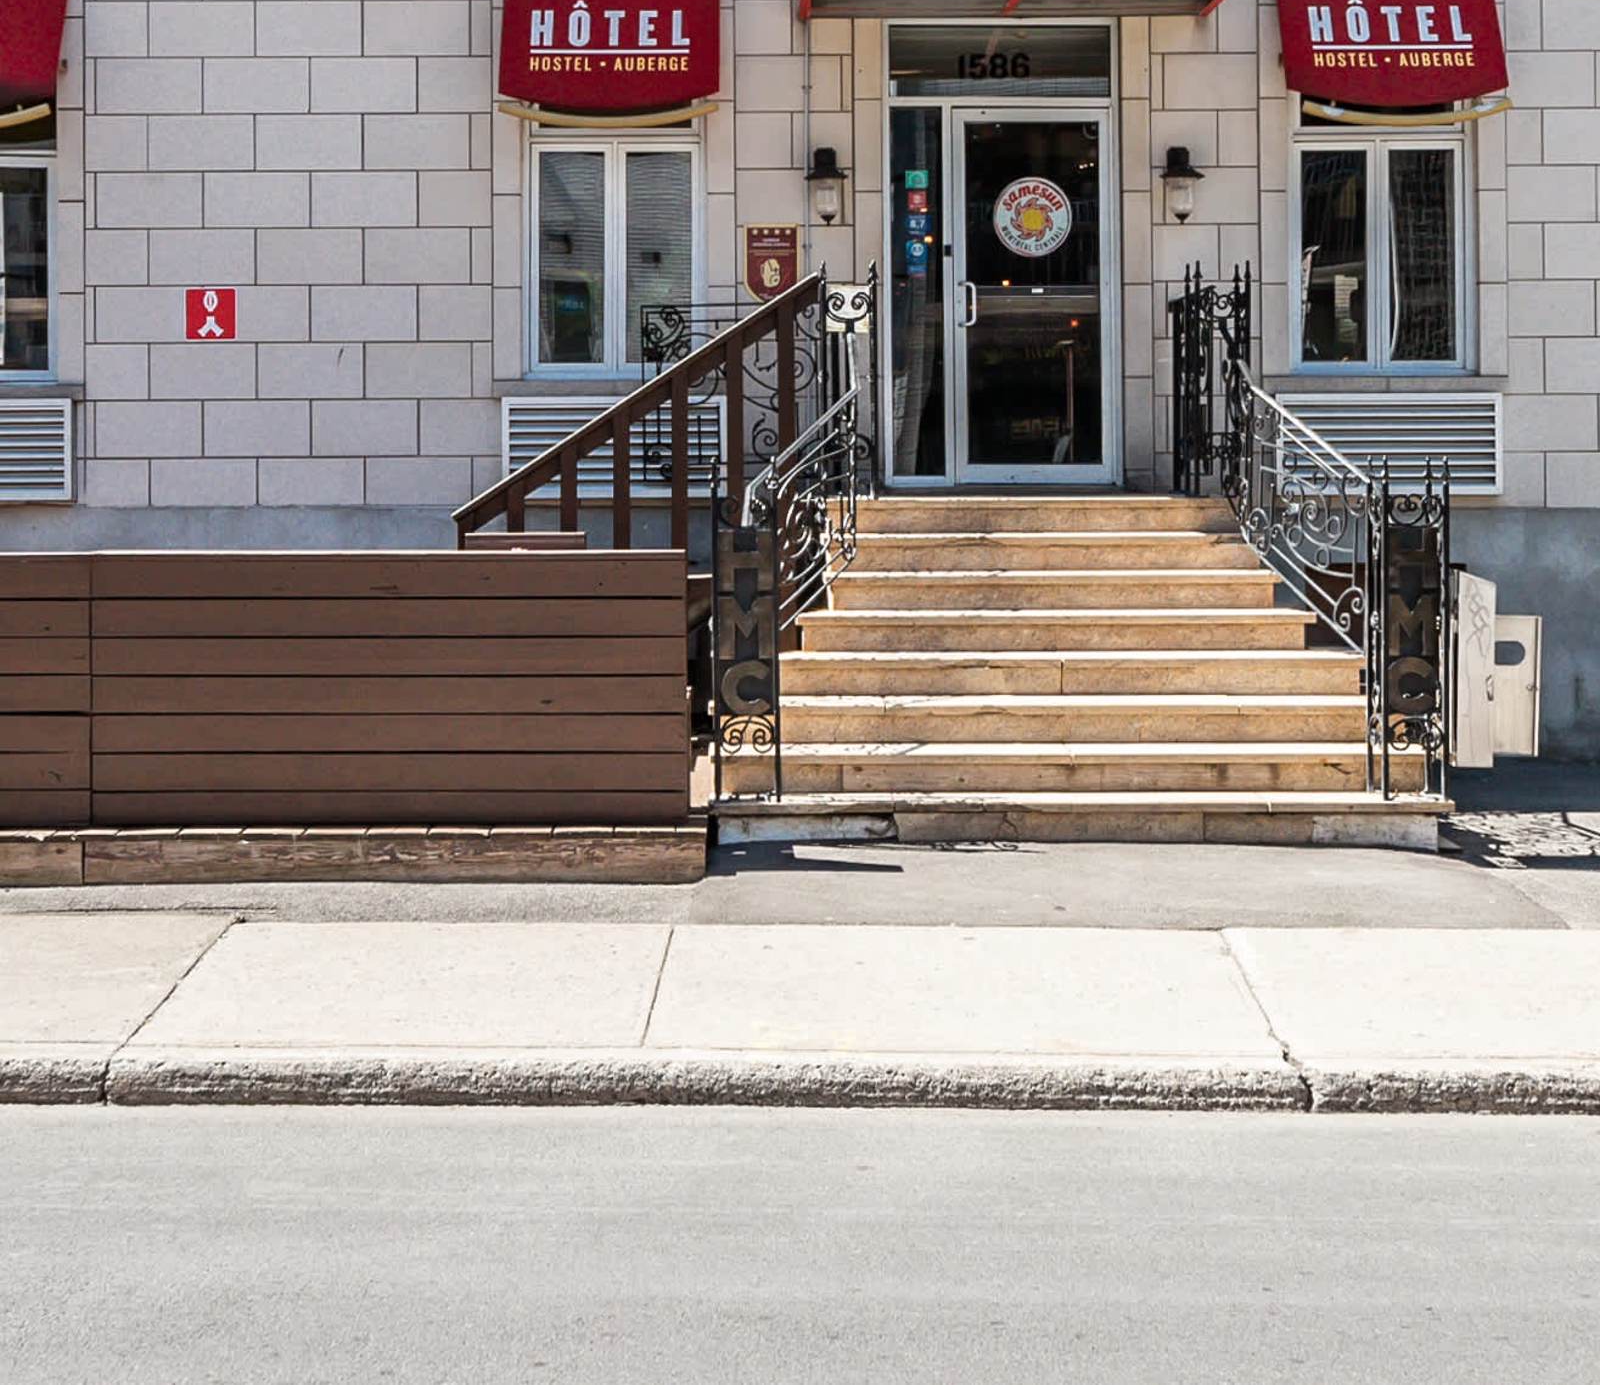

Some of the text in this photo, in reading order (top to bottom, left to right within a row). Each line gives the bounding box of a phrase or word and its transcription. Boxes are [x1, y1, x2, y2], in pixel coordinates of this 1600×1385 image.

[530, 0, 690, 47] HÔTEL
[530, 56, 689, 72] HOSTEL AUBERGE
[958, 53, 1031, 80] 1586
[1314, 51, 1475, 67] HOSTEL AUBERGE
